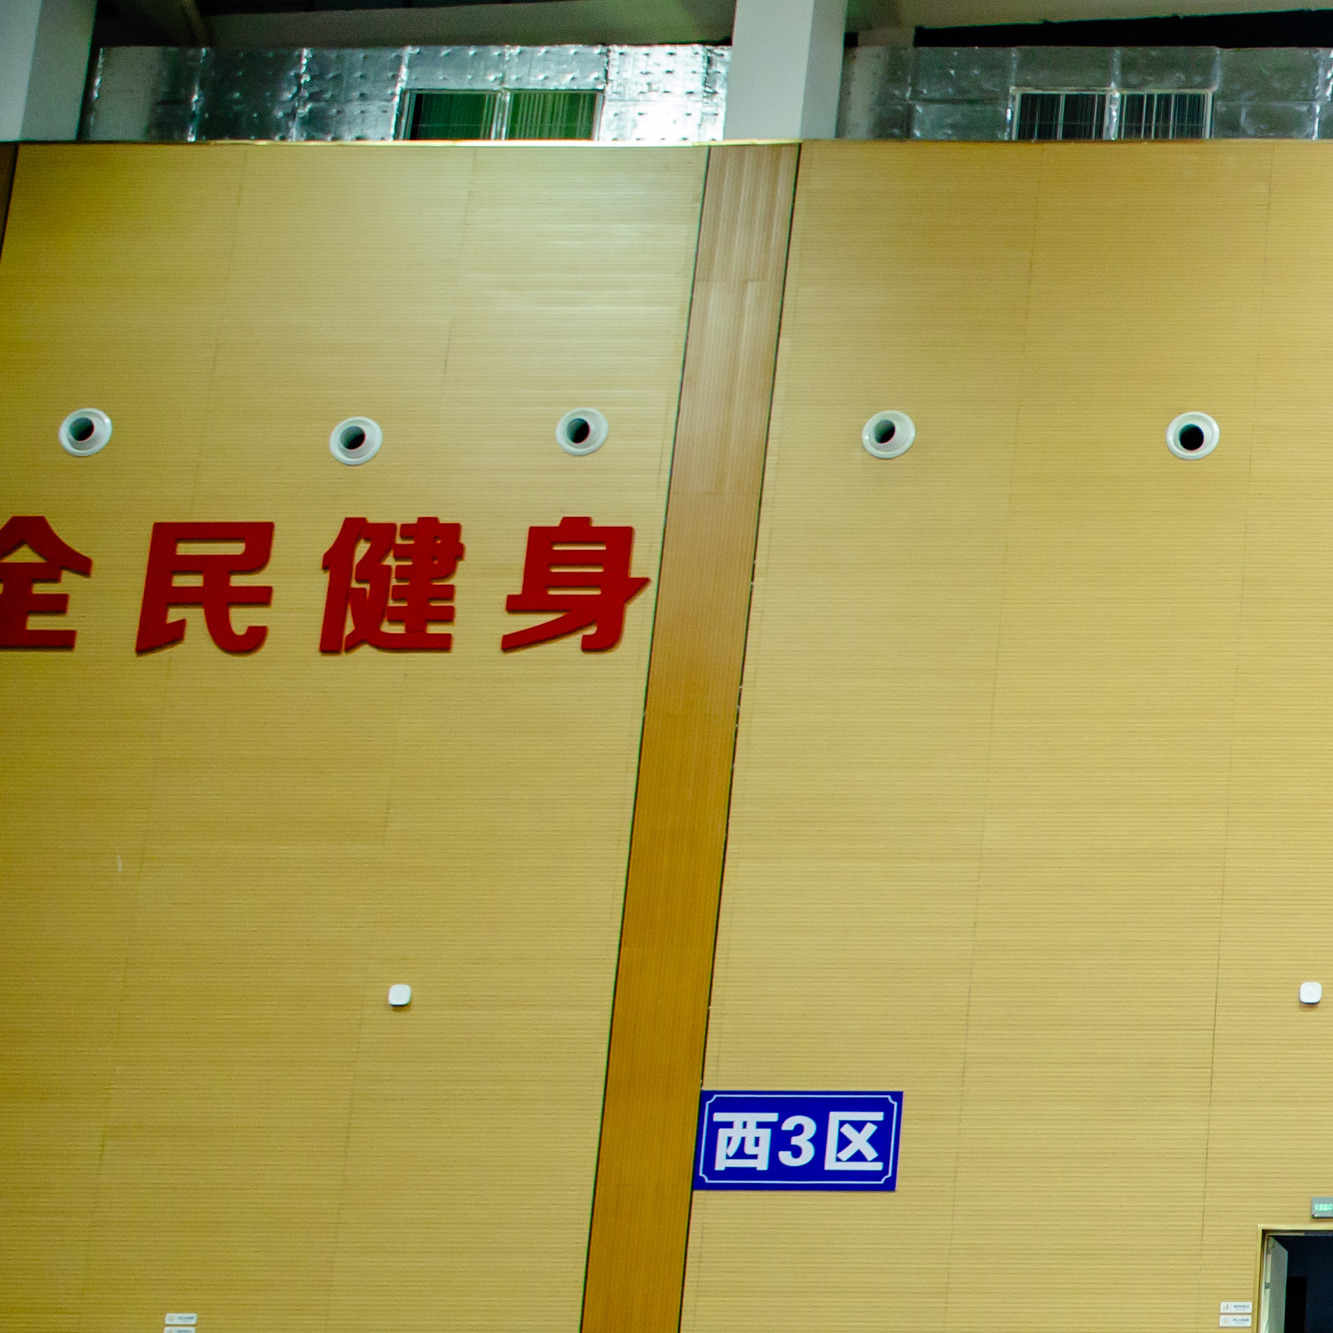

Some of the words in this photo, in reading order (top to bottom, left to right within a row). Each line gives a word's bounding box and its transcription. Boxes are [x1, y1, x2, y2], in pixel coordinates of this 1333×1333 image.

[0, 515, 651, 655] 全民健身
[712, 1111, 884, 1171] 西3区
